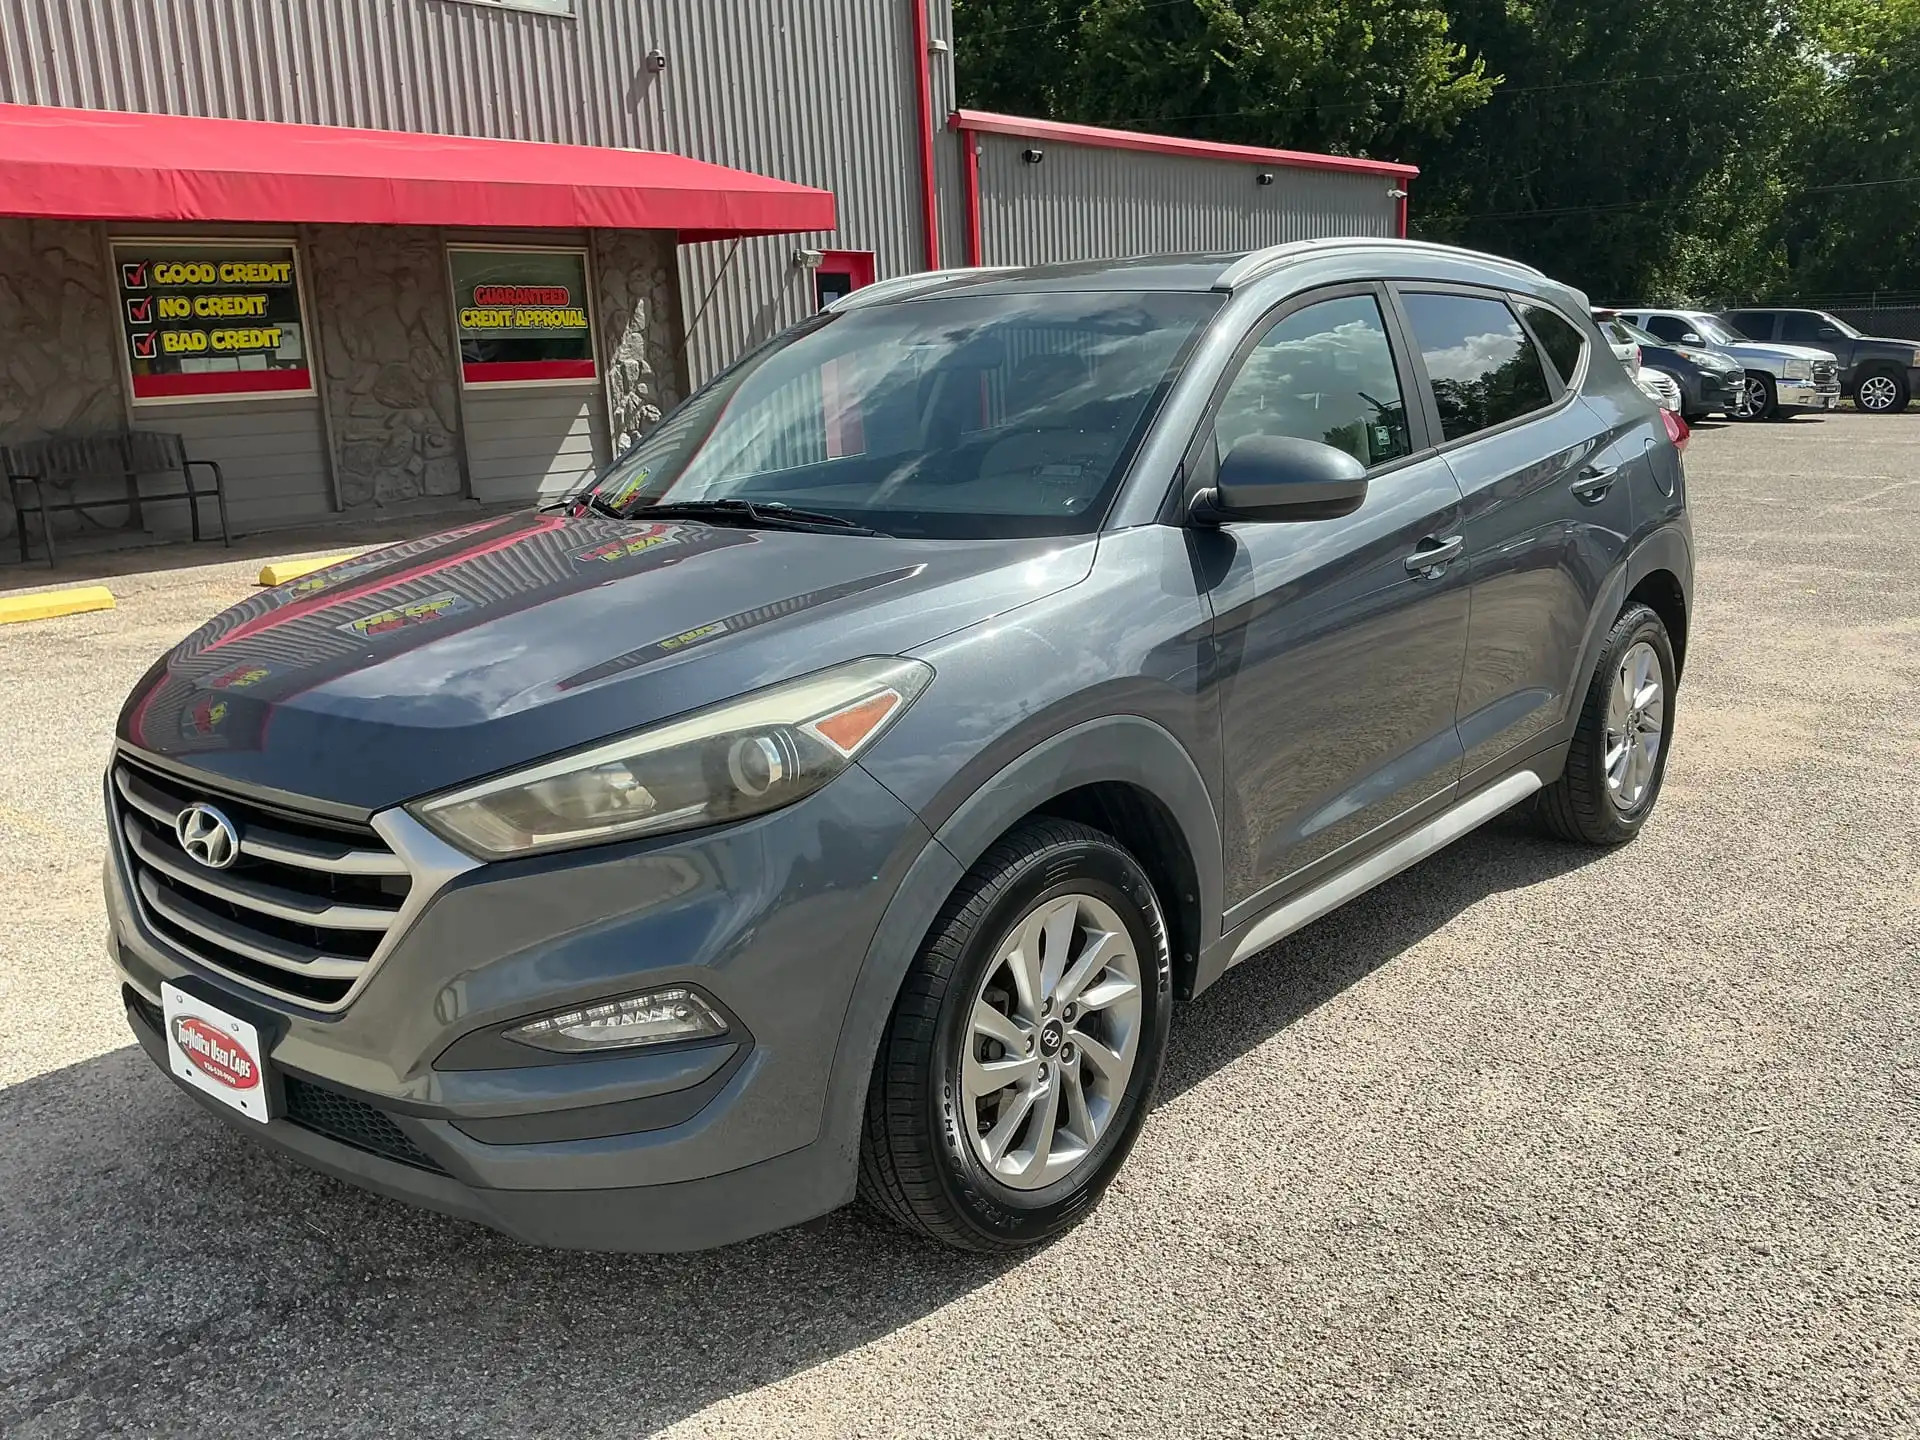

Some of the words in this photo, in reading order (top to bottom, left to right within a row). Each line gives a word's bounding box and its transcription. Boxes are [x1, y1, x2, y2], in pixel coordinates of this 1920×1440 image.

[153, 263, 216, 284] GOOD
[219, 263, 292, 283] CREDIT
[475, 287, 568, 305] GUARANTEED
[158, 297, 191, 318] NO
[194, 296, 267, 317] CREDIT
[460, 309, 513, 328] CREDIT
[515, 309, 587, 328] APPROVAL
[162, 332, 208, 353] BAD
[210, 329, 282, 350] CREDIT
